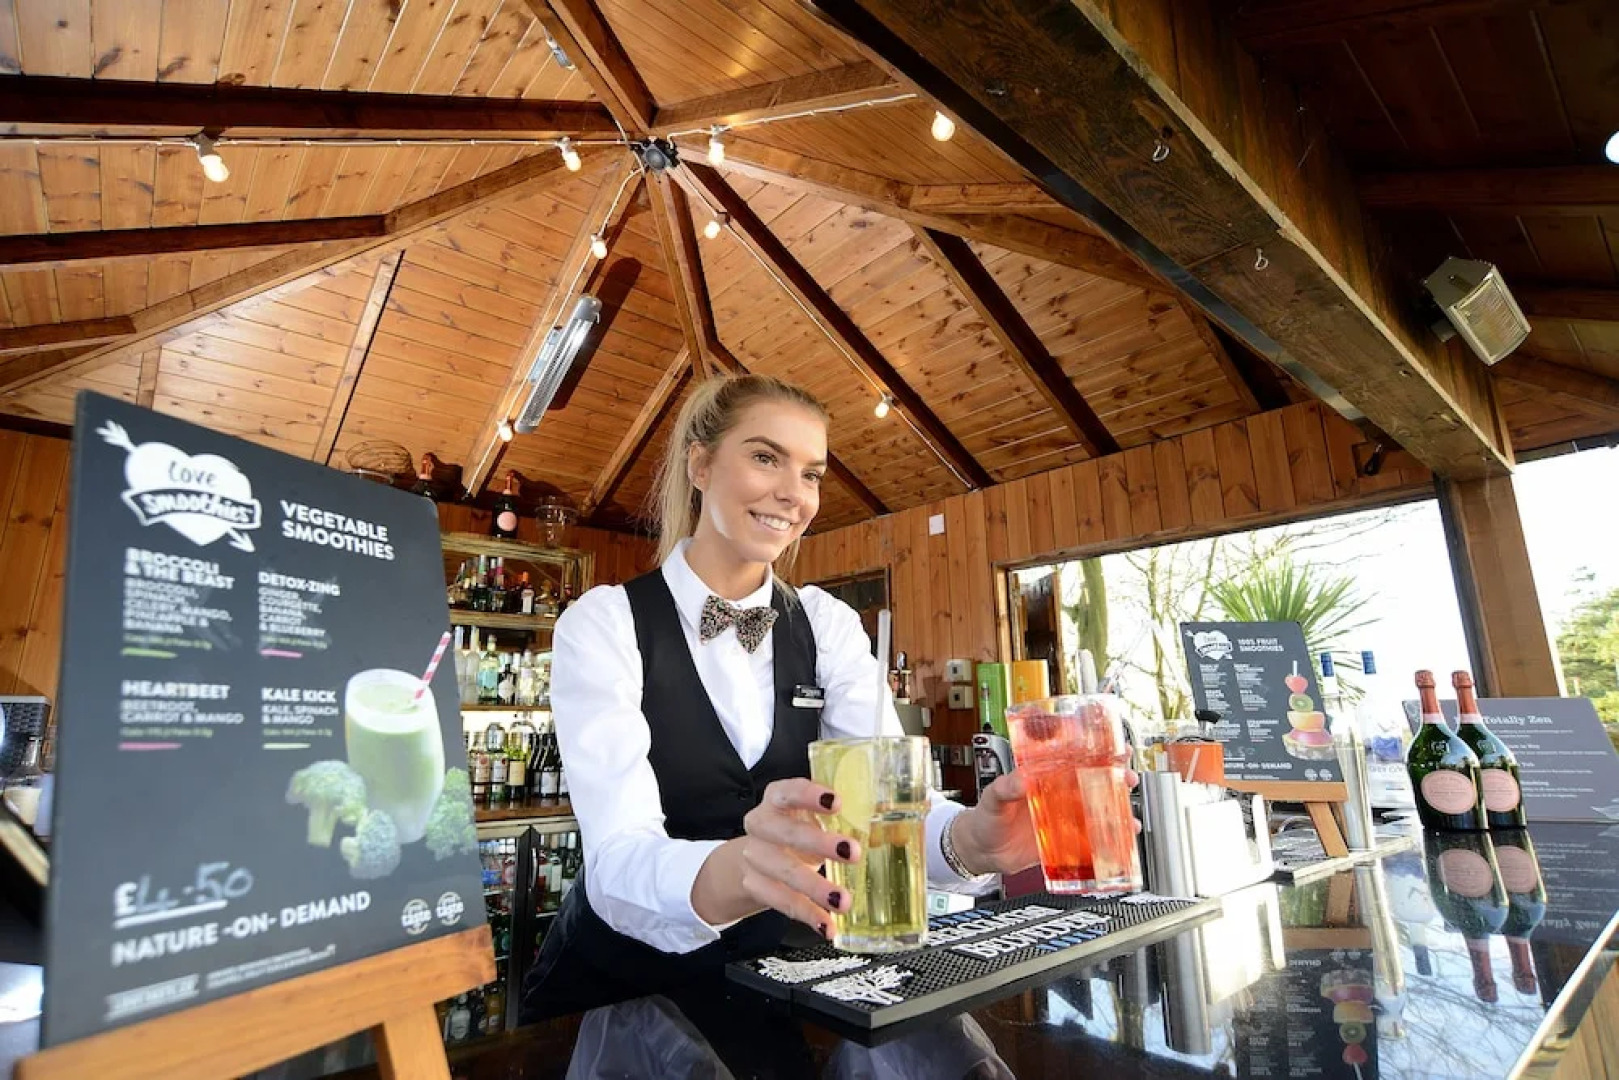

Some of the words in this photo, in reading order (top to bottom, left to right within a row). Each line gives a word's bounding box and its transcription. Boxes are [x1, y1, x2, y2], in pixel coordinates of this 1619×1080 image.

[280, 499, 389, 542] VEGETABLE
[281, 519, 395, 560] SMOOTHIES
[126, 547, 220, 575] BROCCOLI
[143, 563, 180, 582] THE
[181, 569, 235, 589] BEAST
[258, 571, 341, 596] DETOX-ZING
[121, 679, 231, 700] HEARTBEET
[261, 687, 301, 702] KALE
[303, 689, 337, 704] KICK
[111, 922, 219, 969] NATURE
[280, 890, 372, 929] DEMAND
